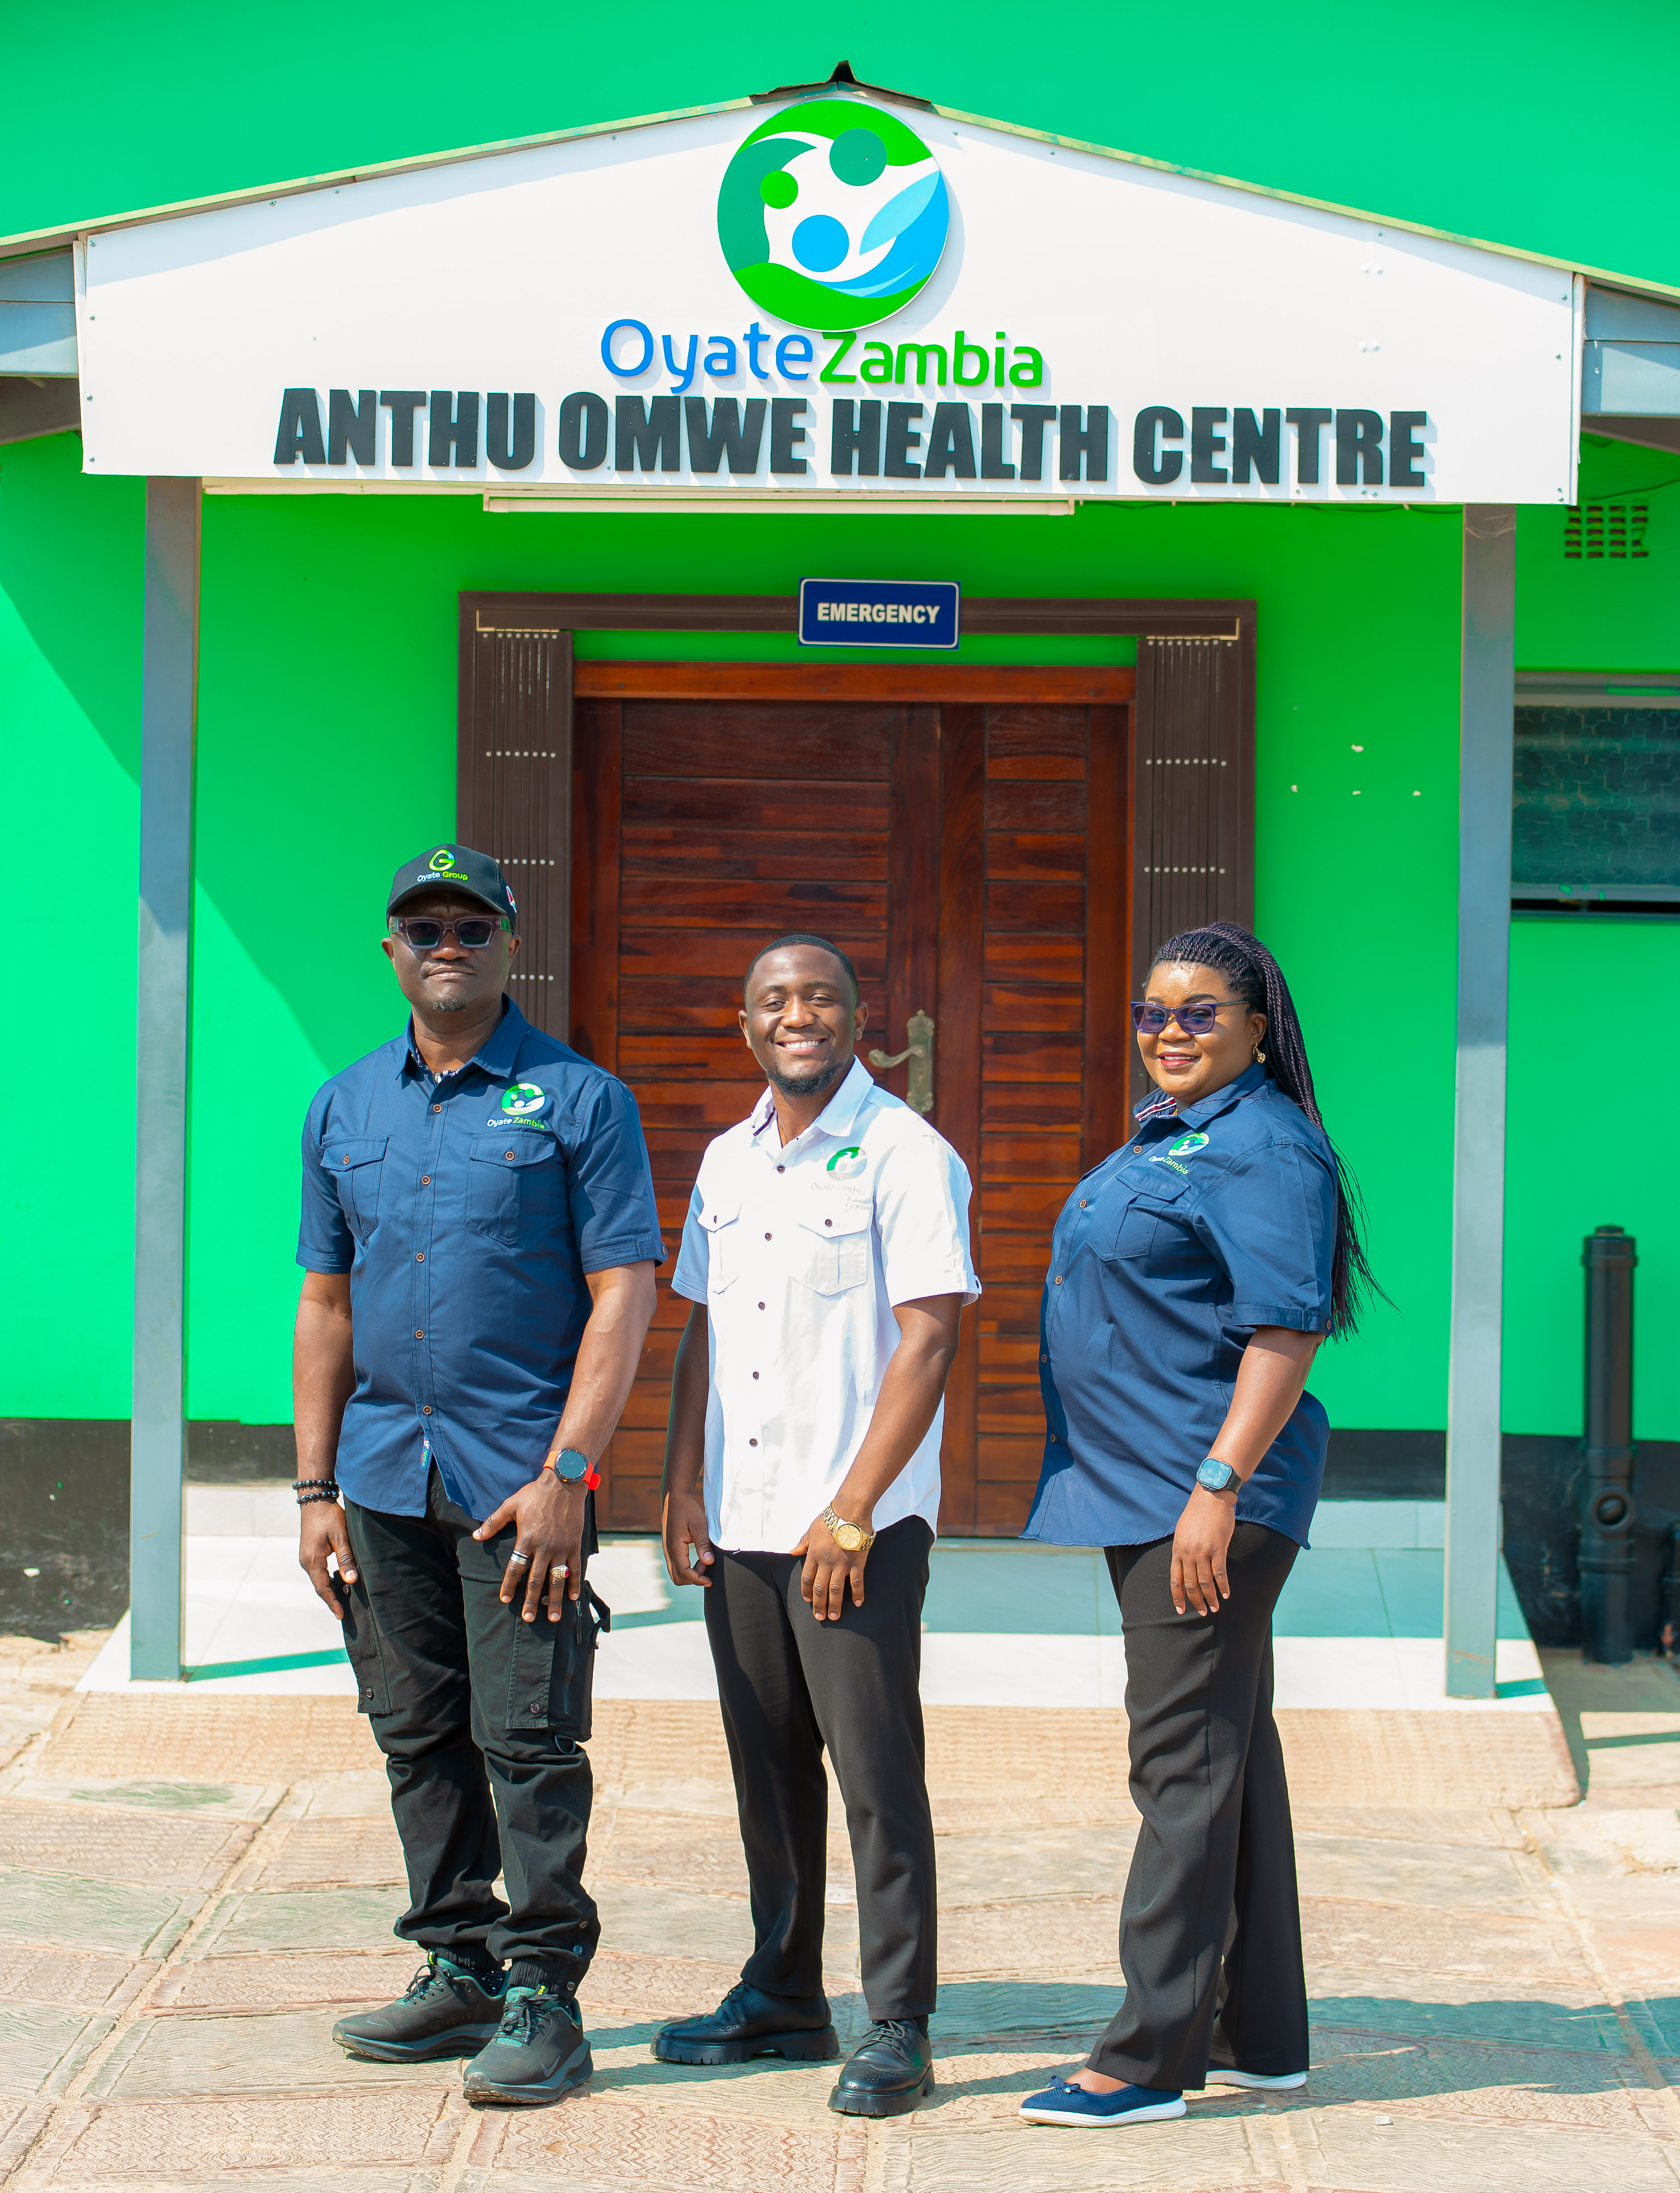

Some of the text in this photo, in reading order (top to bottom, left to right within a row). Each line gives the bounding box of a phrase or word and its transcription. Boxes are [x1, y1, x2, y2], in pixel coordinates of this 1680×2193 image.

[273, 388, 1427, 488] ANTHU OMWE HEALTH CENTRE
[817, 602, 940, 624] EMERGENCY
[417, 871, 468, 883] Oyate Group
